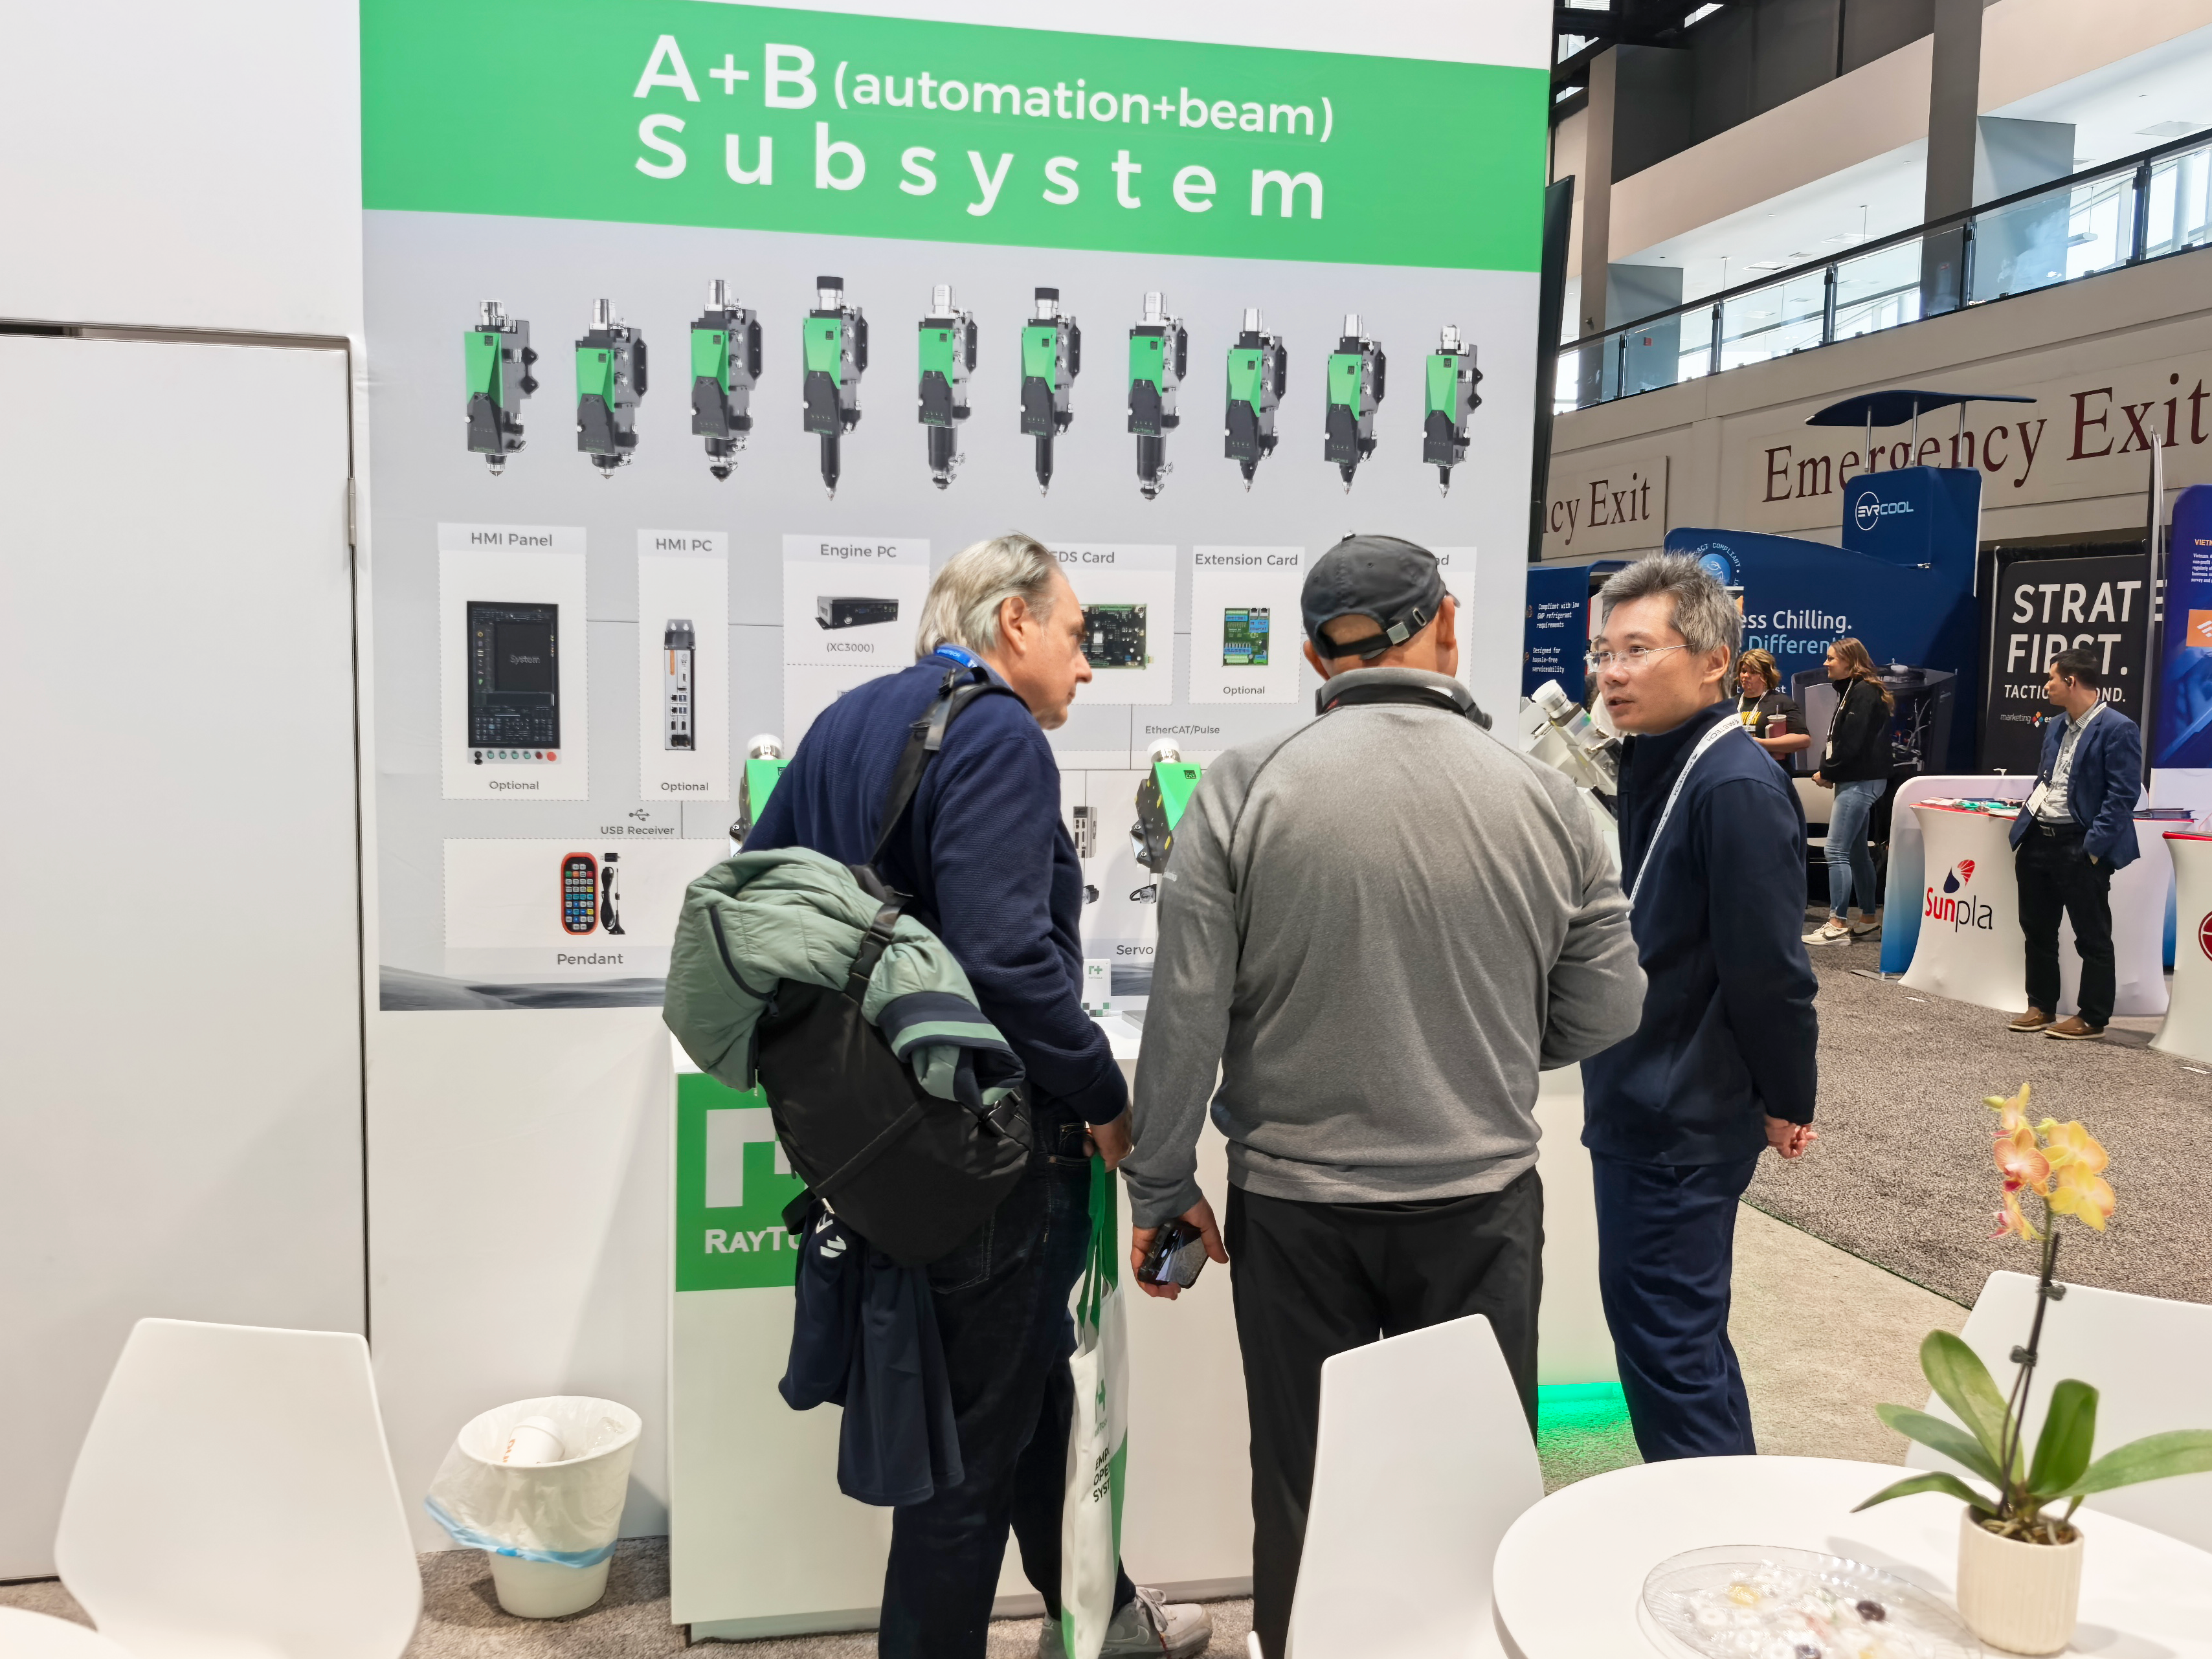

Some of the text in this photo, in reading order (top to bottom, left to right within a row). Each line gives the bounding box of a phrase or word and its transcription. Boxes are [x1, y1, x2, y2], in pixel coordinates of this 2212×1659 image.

[633, 34, 1334, 143] A+B (automation+beam)
[634, 114, 1324, 220] Subsystem
[2066, 373, 2211, 462] Exit
[1587, 472, 1651, 528] Exit
[1857, 500, 1914, 518] EVRCOOL
[471, 532, 553, 547] HMI Panel
[656, 538, 713, 552] HMI PC
[820, 544, 897, 559] Engine PC
[1082, 551, 1115, 564] Card
[1195, 553, 1298, 566] Extension Card
[1772, 609, 1852, 634] Chilling.
[827, 643, 875, 654] (XC3000)
[1749, 634, 1844, 654] Differen
[1223, 685, 1265, 696] Optional
[1145, 725, 1220, 735] EtherCAT/Pulse
[489, 781, 539, 792] Optional
[661, 782, 709, 793] Optional
[601, 826, 675, 836] USB Receiver
[1924, 886, 1993, 933] Sunpla
[1116, 944, 1154, 955] Servo
[557, 953, 624, 965] Pendant
[1095, 1447, 1110, 1471] EMP
